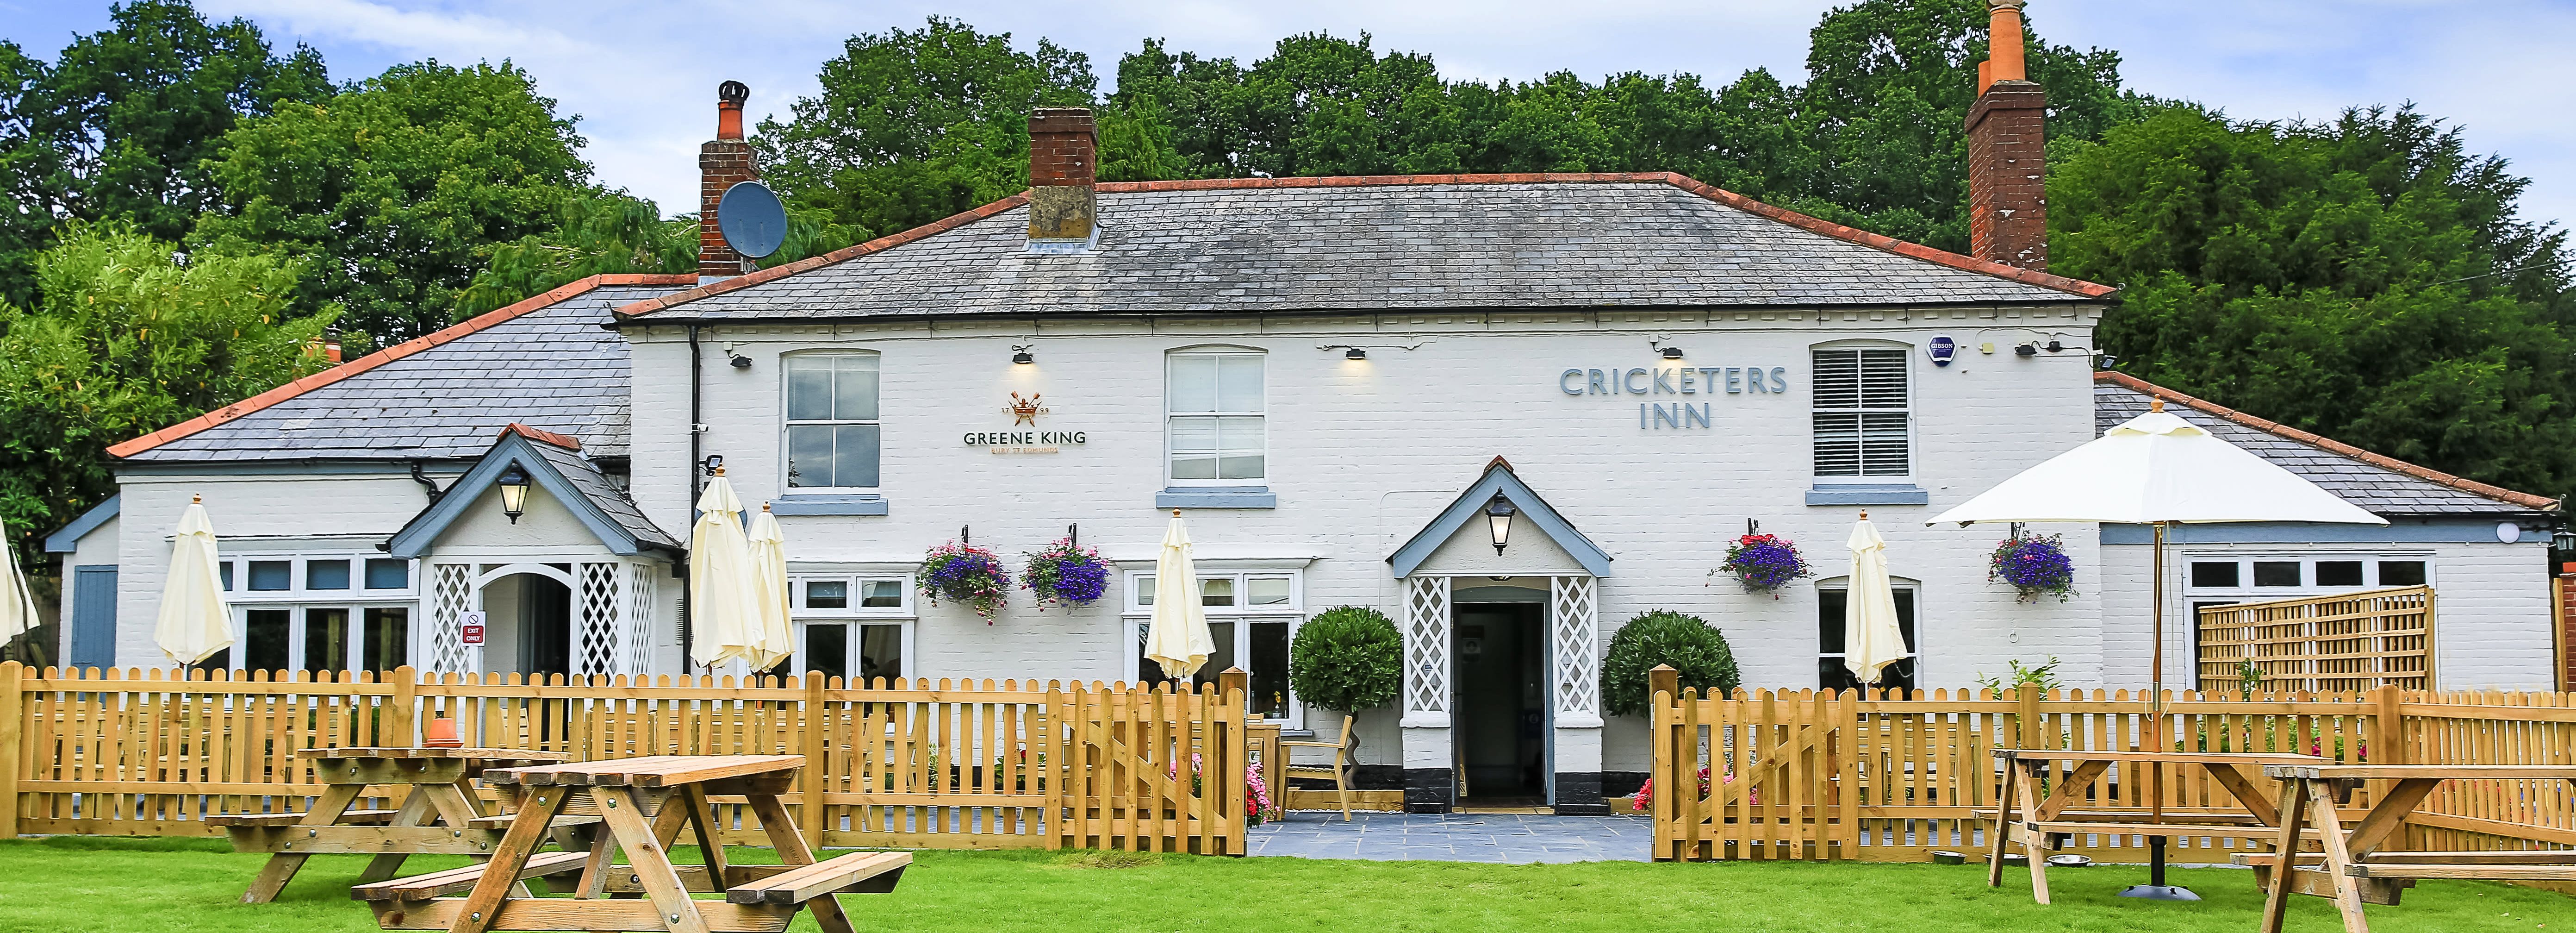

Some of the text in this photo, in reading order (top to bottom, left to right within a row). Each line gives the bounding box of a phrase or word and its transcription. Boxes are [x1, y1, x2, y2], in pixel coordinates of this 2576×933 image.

[1559, 367, 1787, 395] CRICKETERS
[1640, 402, 1711, 429] INN
[963, 431, 1086, 445] GREENE KING
